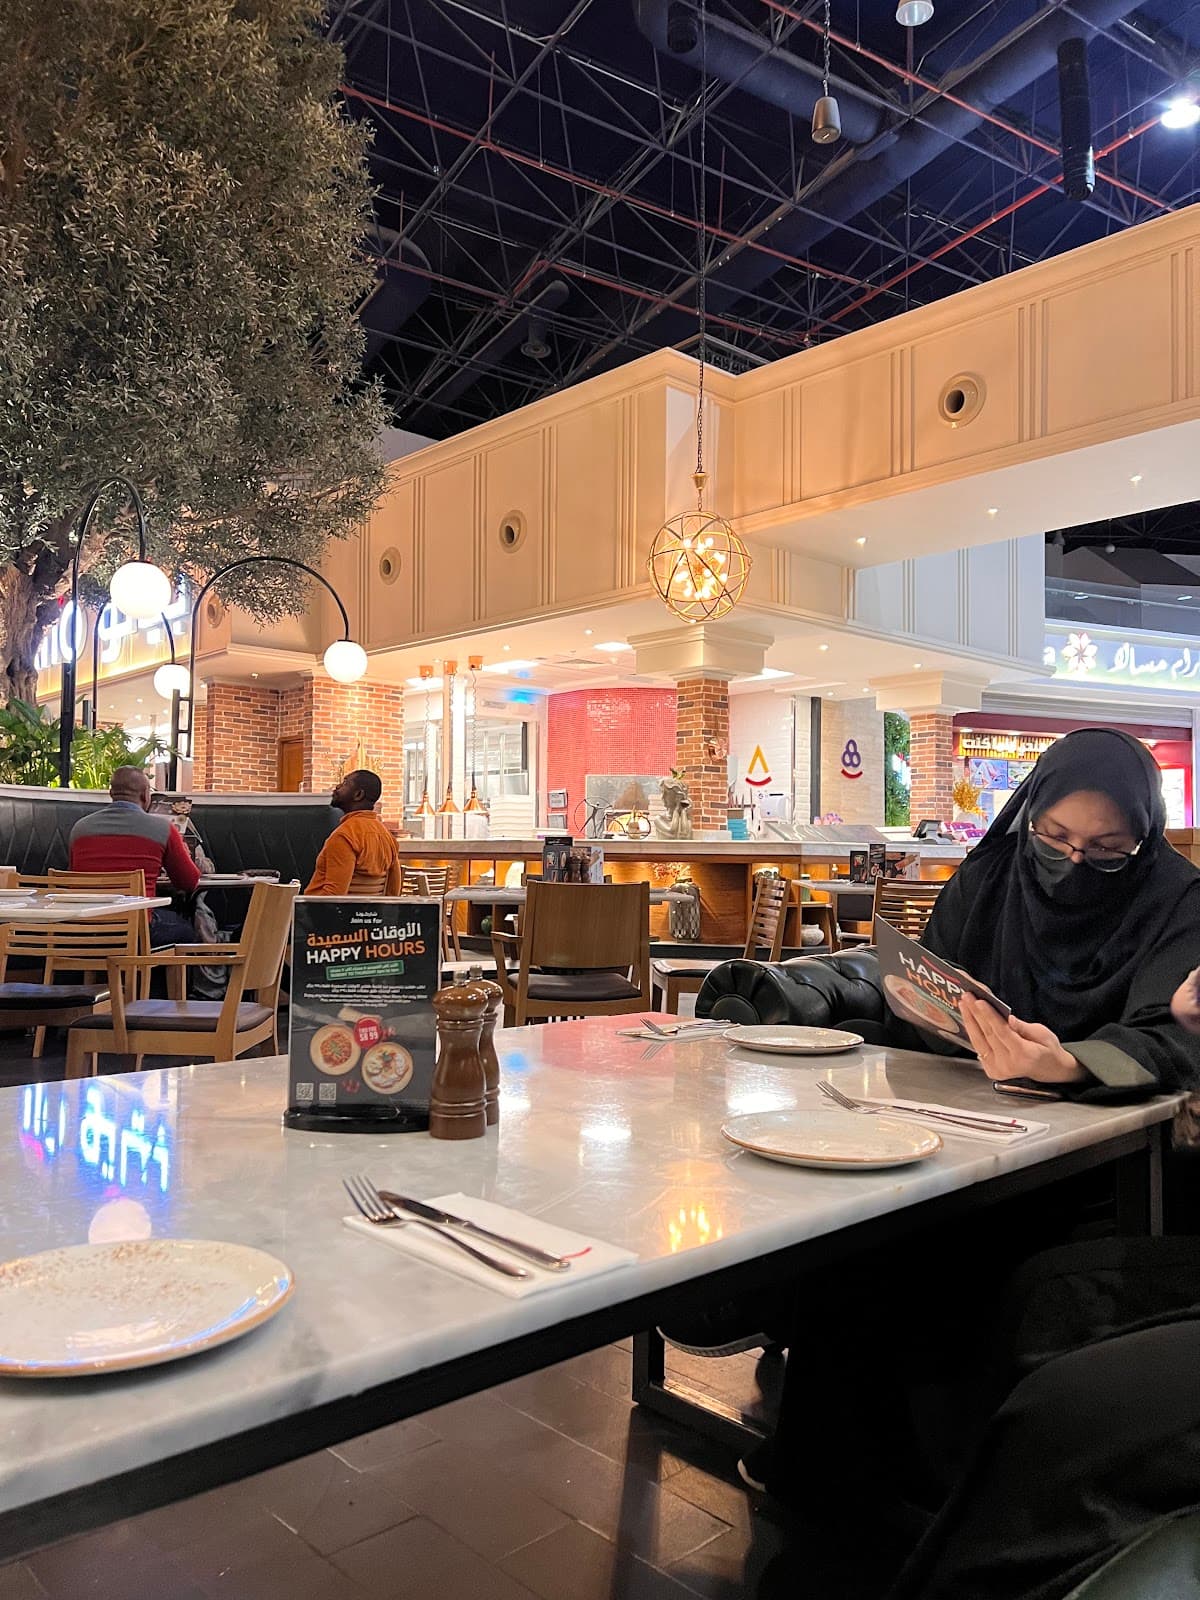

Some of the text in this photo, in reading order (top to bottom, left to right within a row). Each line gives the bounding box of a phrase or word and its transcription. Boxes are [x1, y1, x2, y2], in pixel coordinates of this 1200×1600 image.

[306, 922, 421, 948] الأوقات السعيدة
[306, 940, 426, 965] HAPPY HOURS
